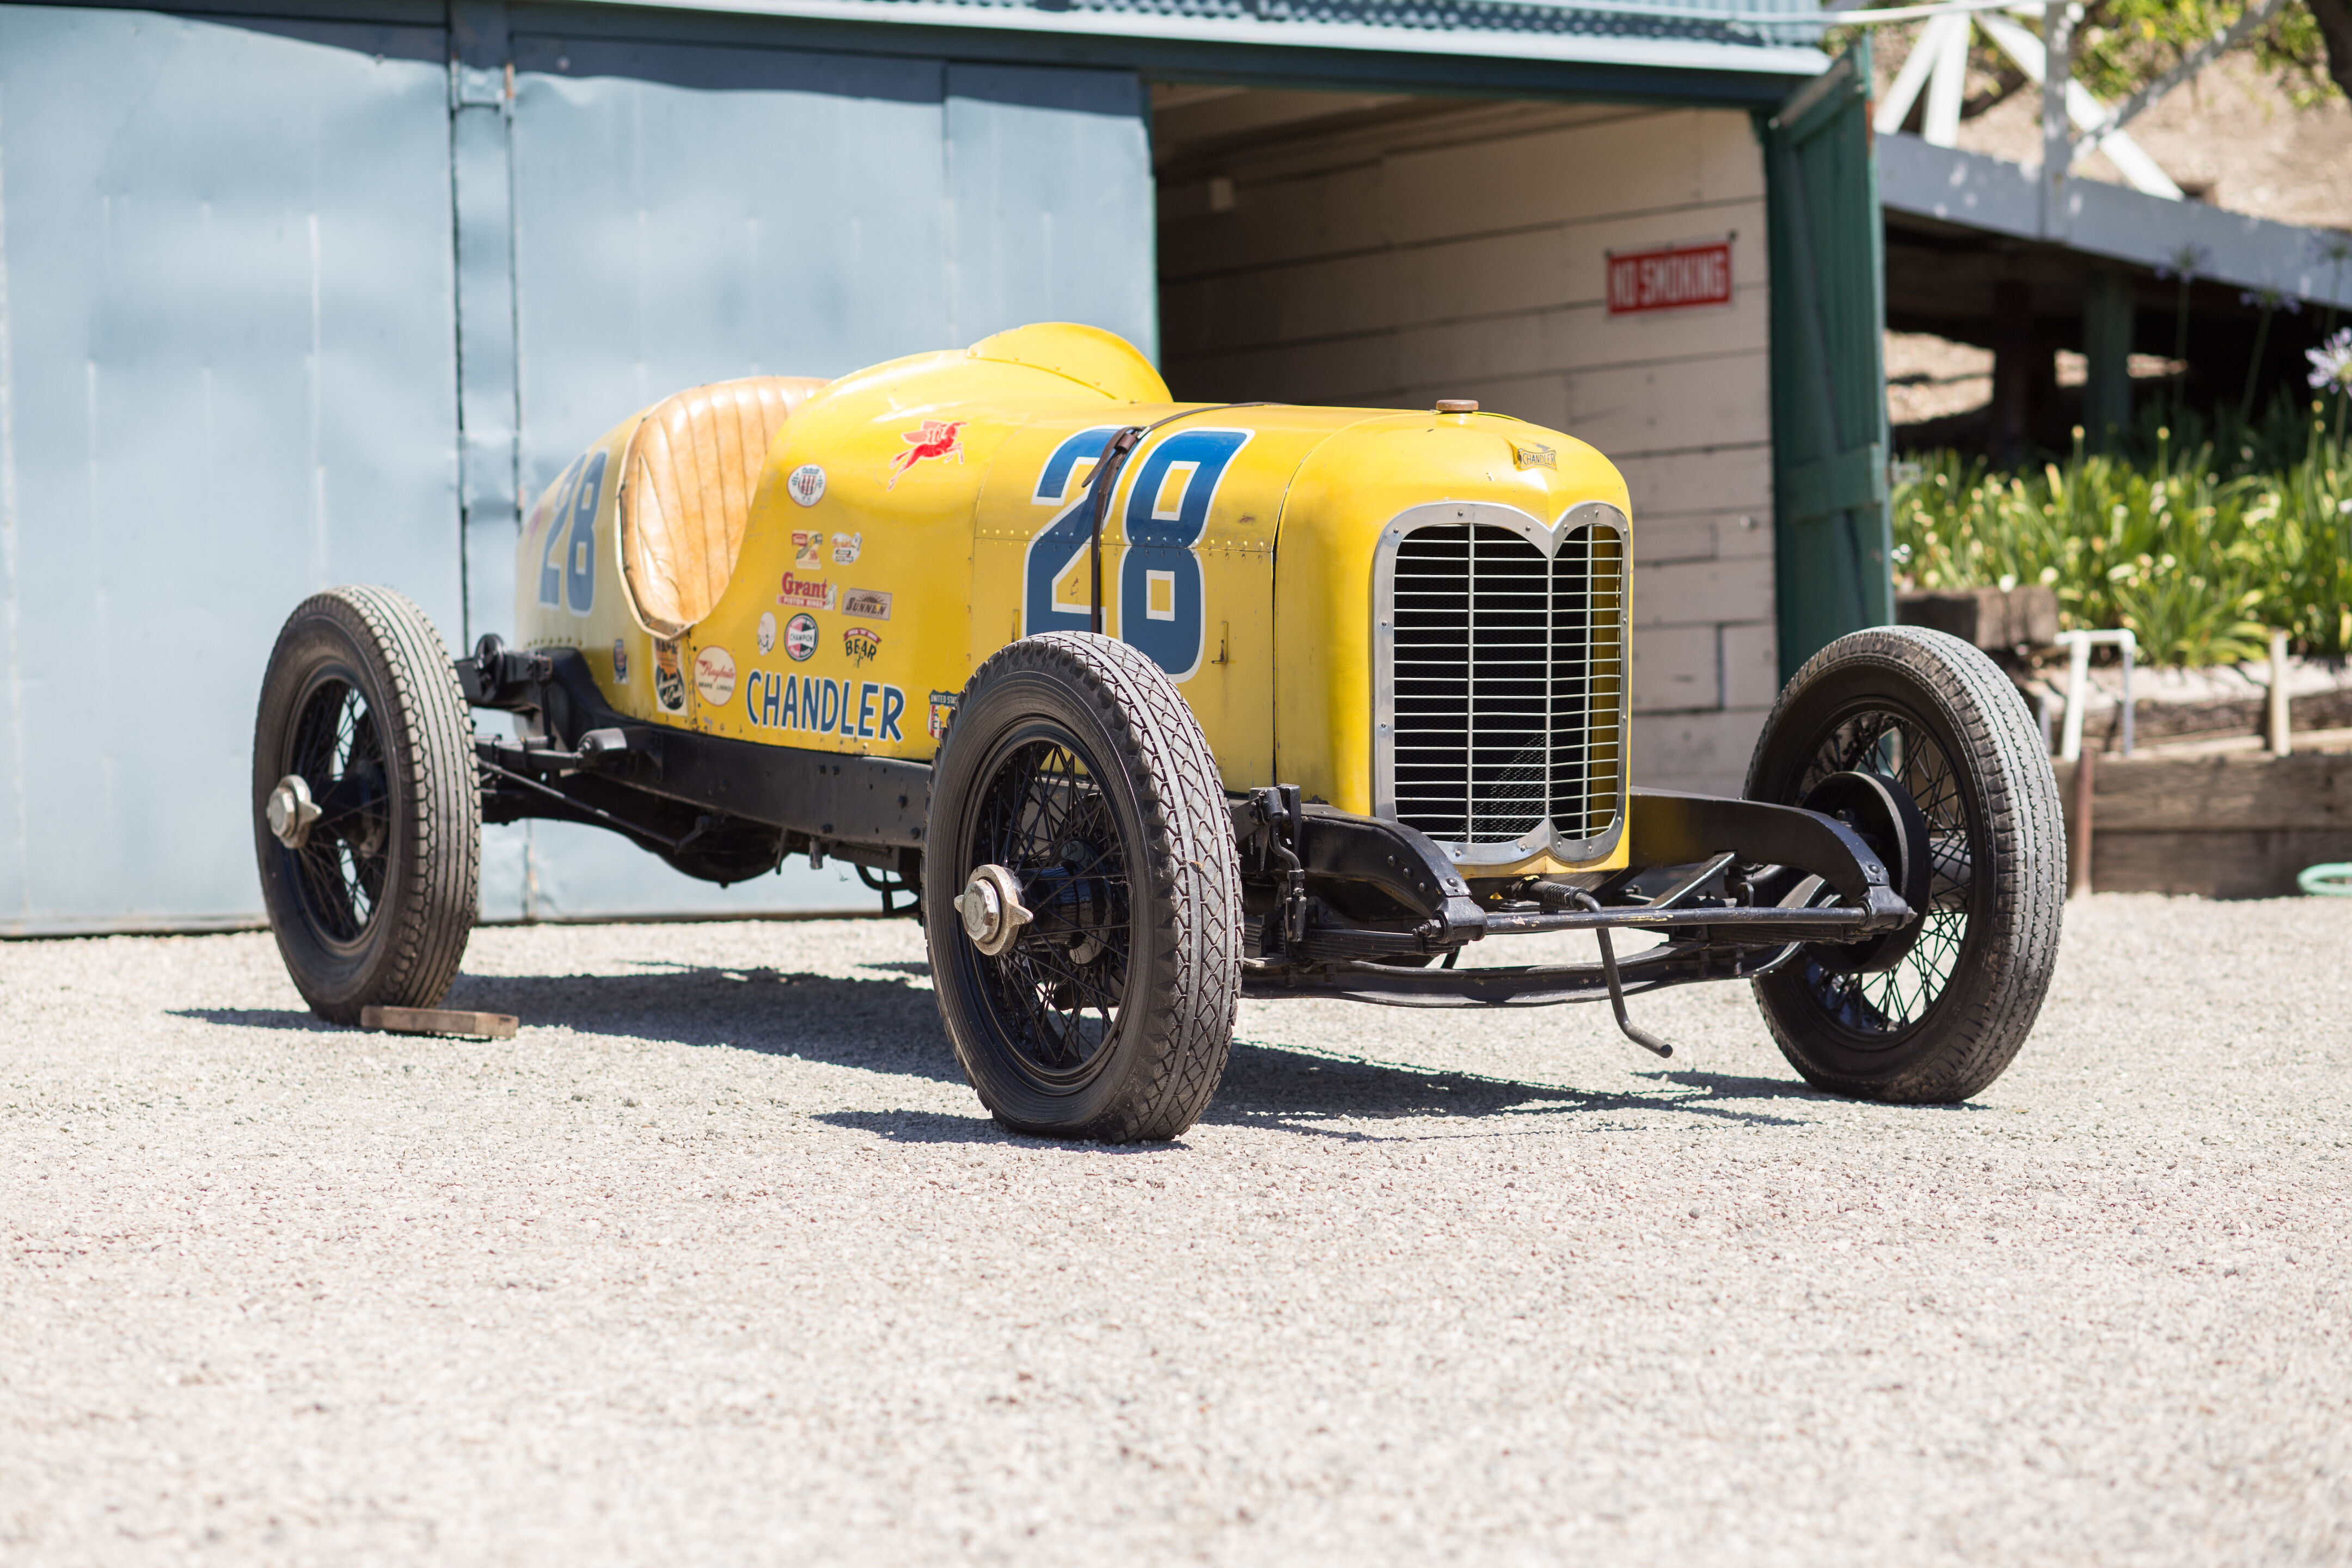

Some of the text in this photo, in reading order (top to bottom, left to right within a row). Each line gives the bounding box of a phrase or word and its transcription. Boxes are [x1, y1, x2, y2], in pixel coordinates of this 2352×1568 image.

[1613, 250, 1725, 308] NO SMOKING
[1522, 450, 1556, 466] CHANDLER
[538, 446, 610, 617] 28
[1022, 425, 1255, 683] 28
[781, 571, 828, 599] Grant
[783, 597, 805, 606] PISTON
[789, 633, 814, 642] CHAMPION
[845, 638, 877, 662] BEAR
[746, 668, 906, 743] CHANDLER
[930, 694, 947, 703] UNITED
